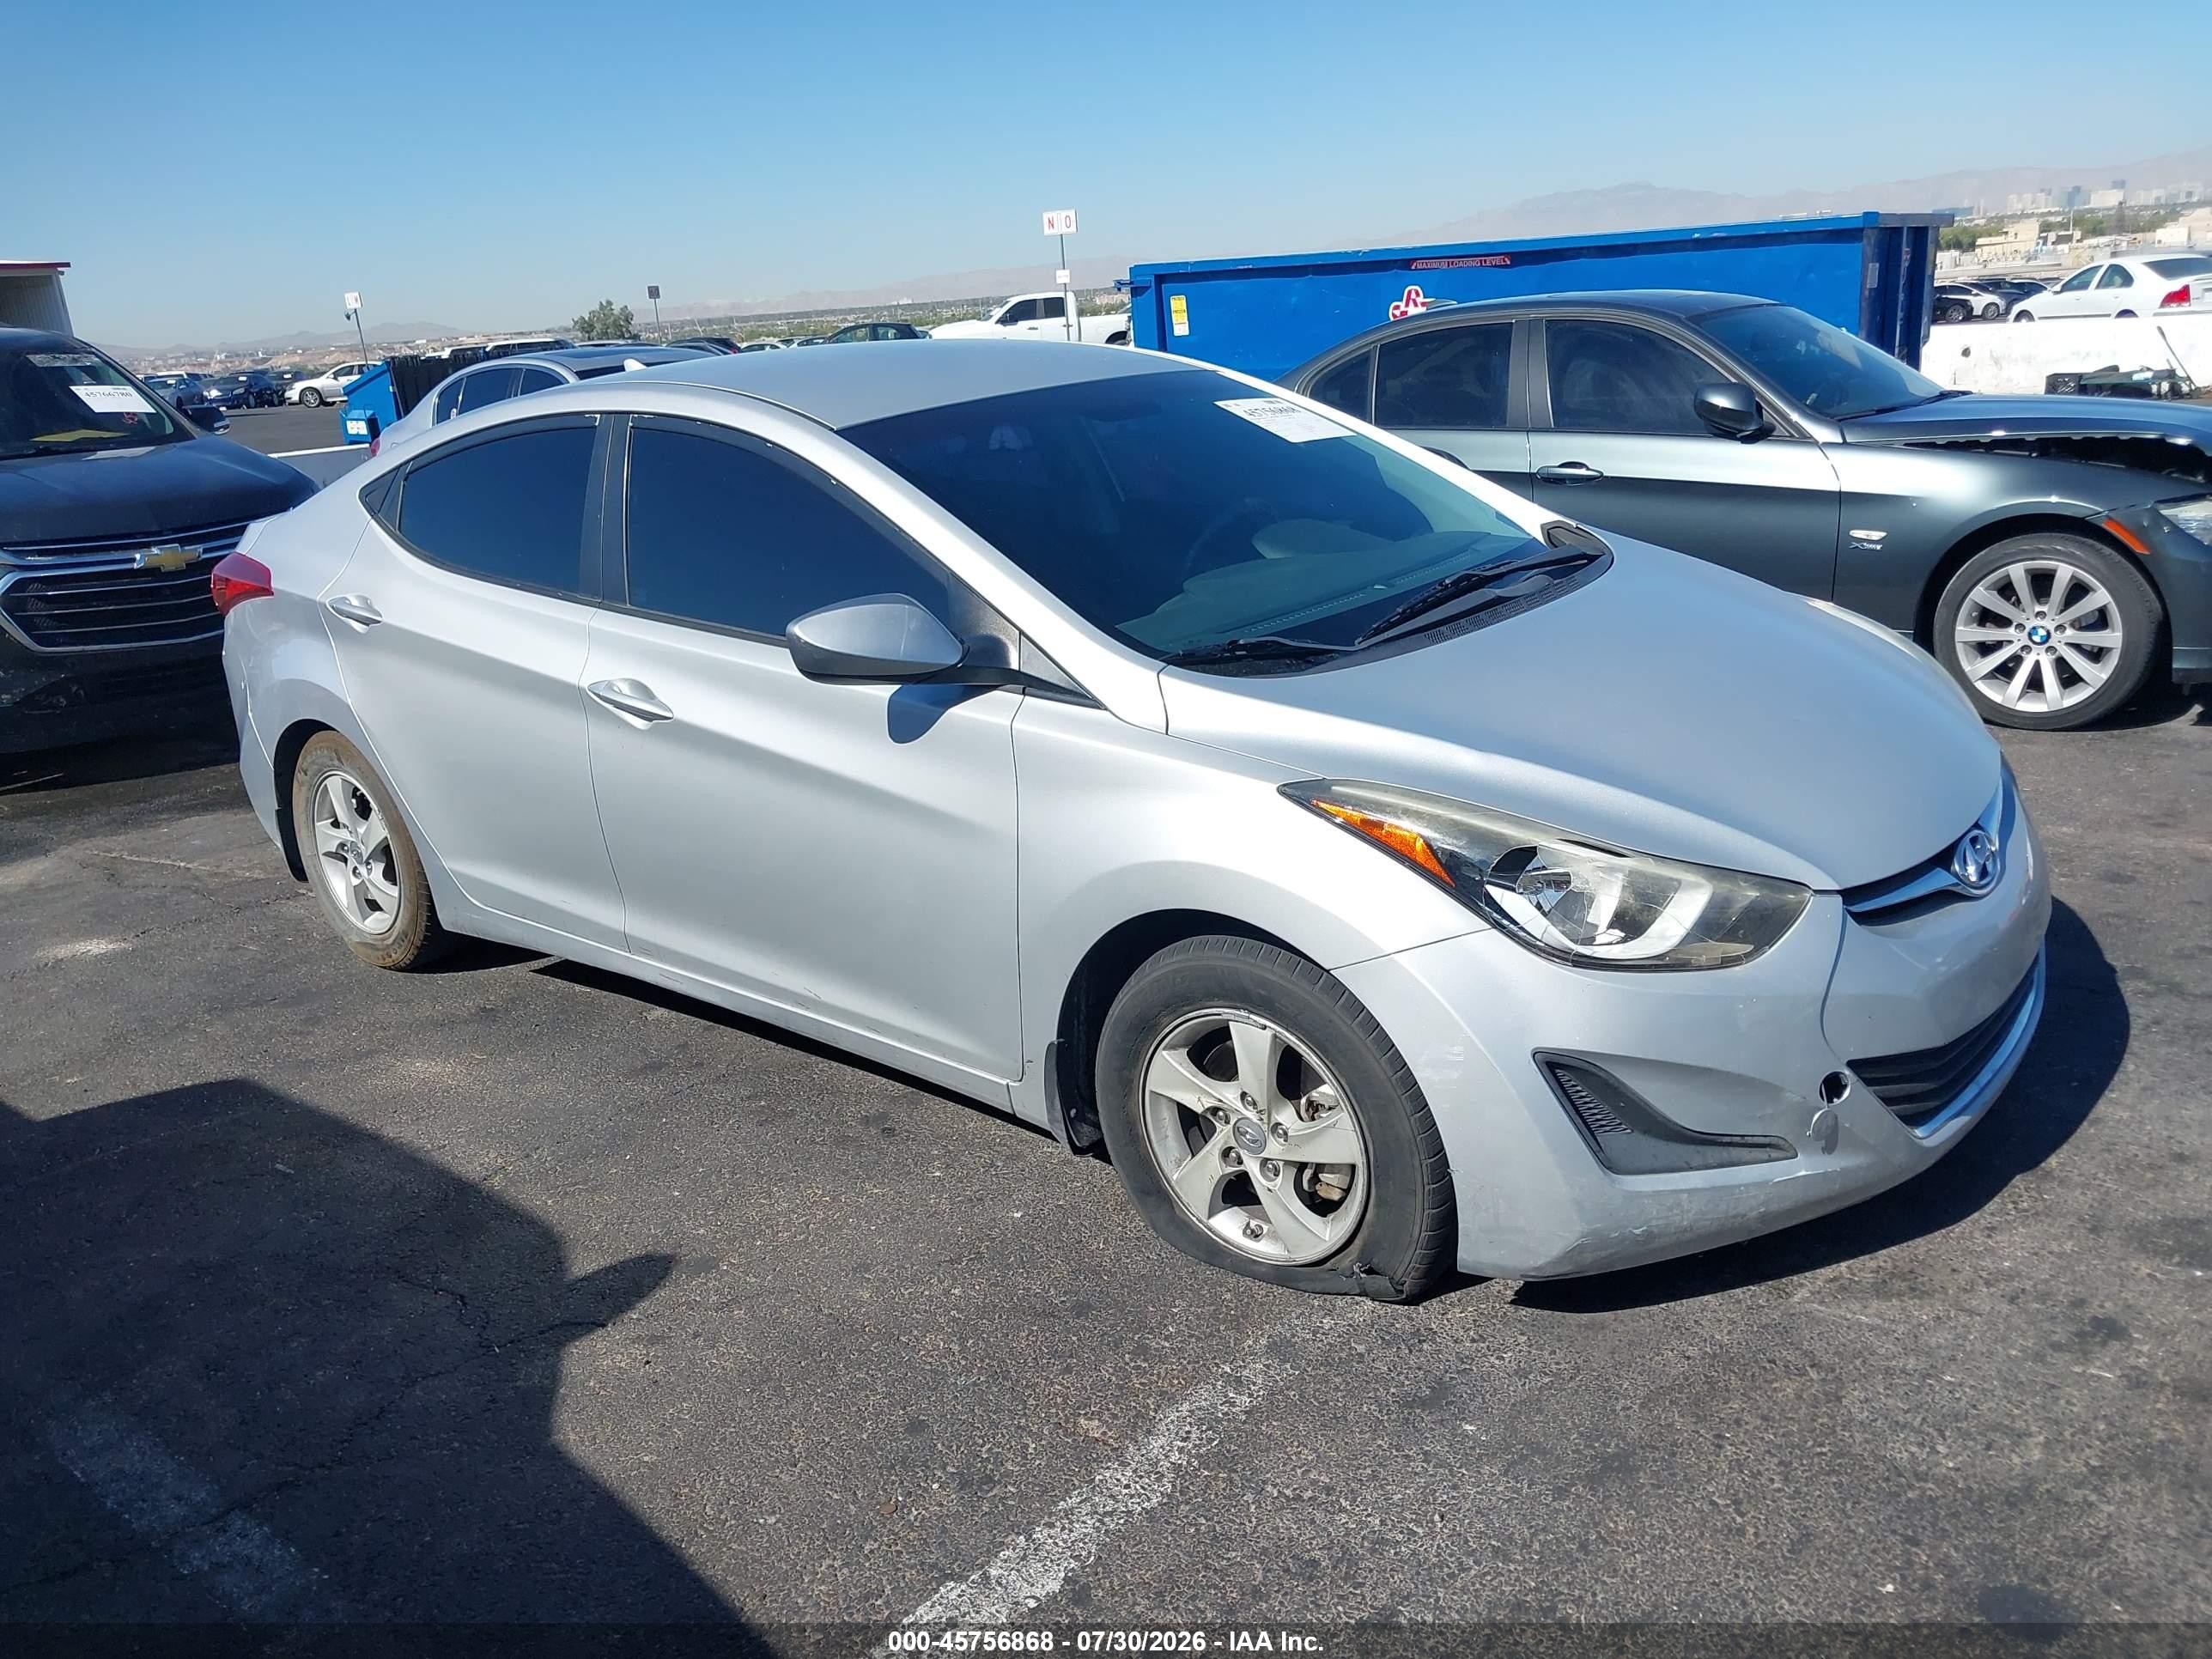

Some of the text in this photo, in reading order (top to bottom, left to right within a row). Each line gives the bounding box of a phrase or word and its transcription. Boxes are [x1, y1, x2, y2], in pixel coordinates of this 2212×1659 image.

[1048, 216, 1054, 230] N
[1416, 258, 1506, 269] MAXIMUM LOADING LEVEL
